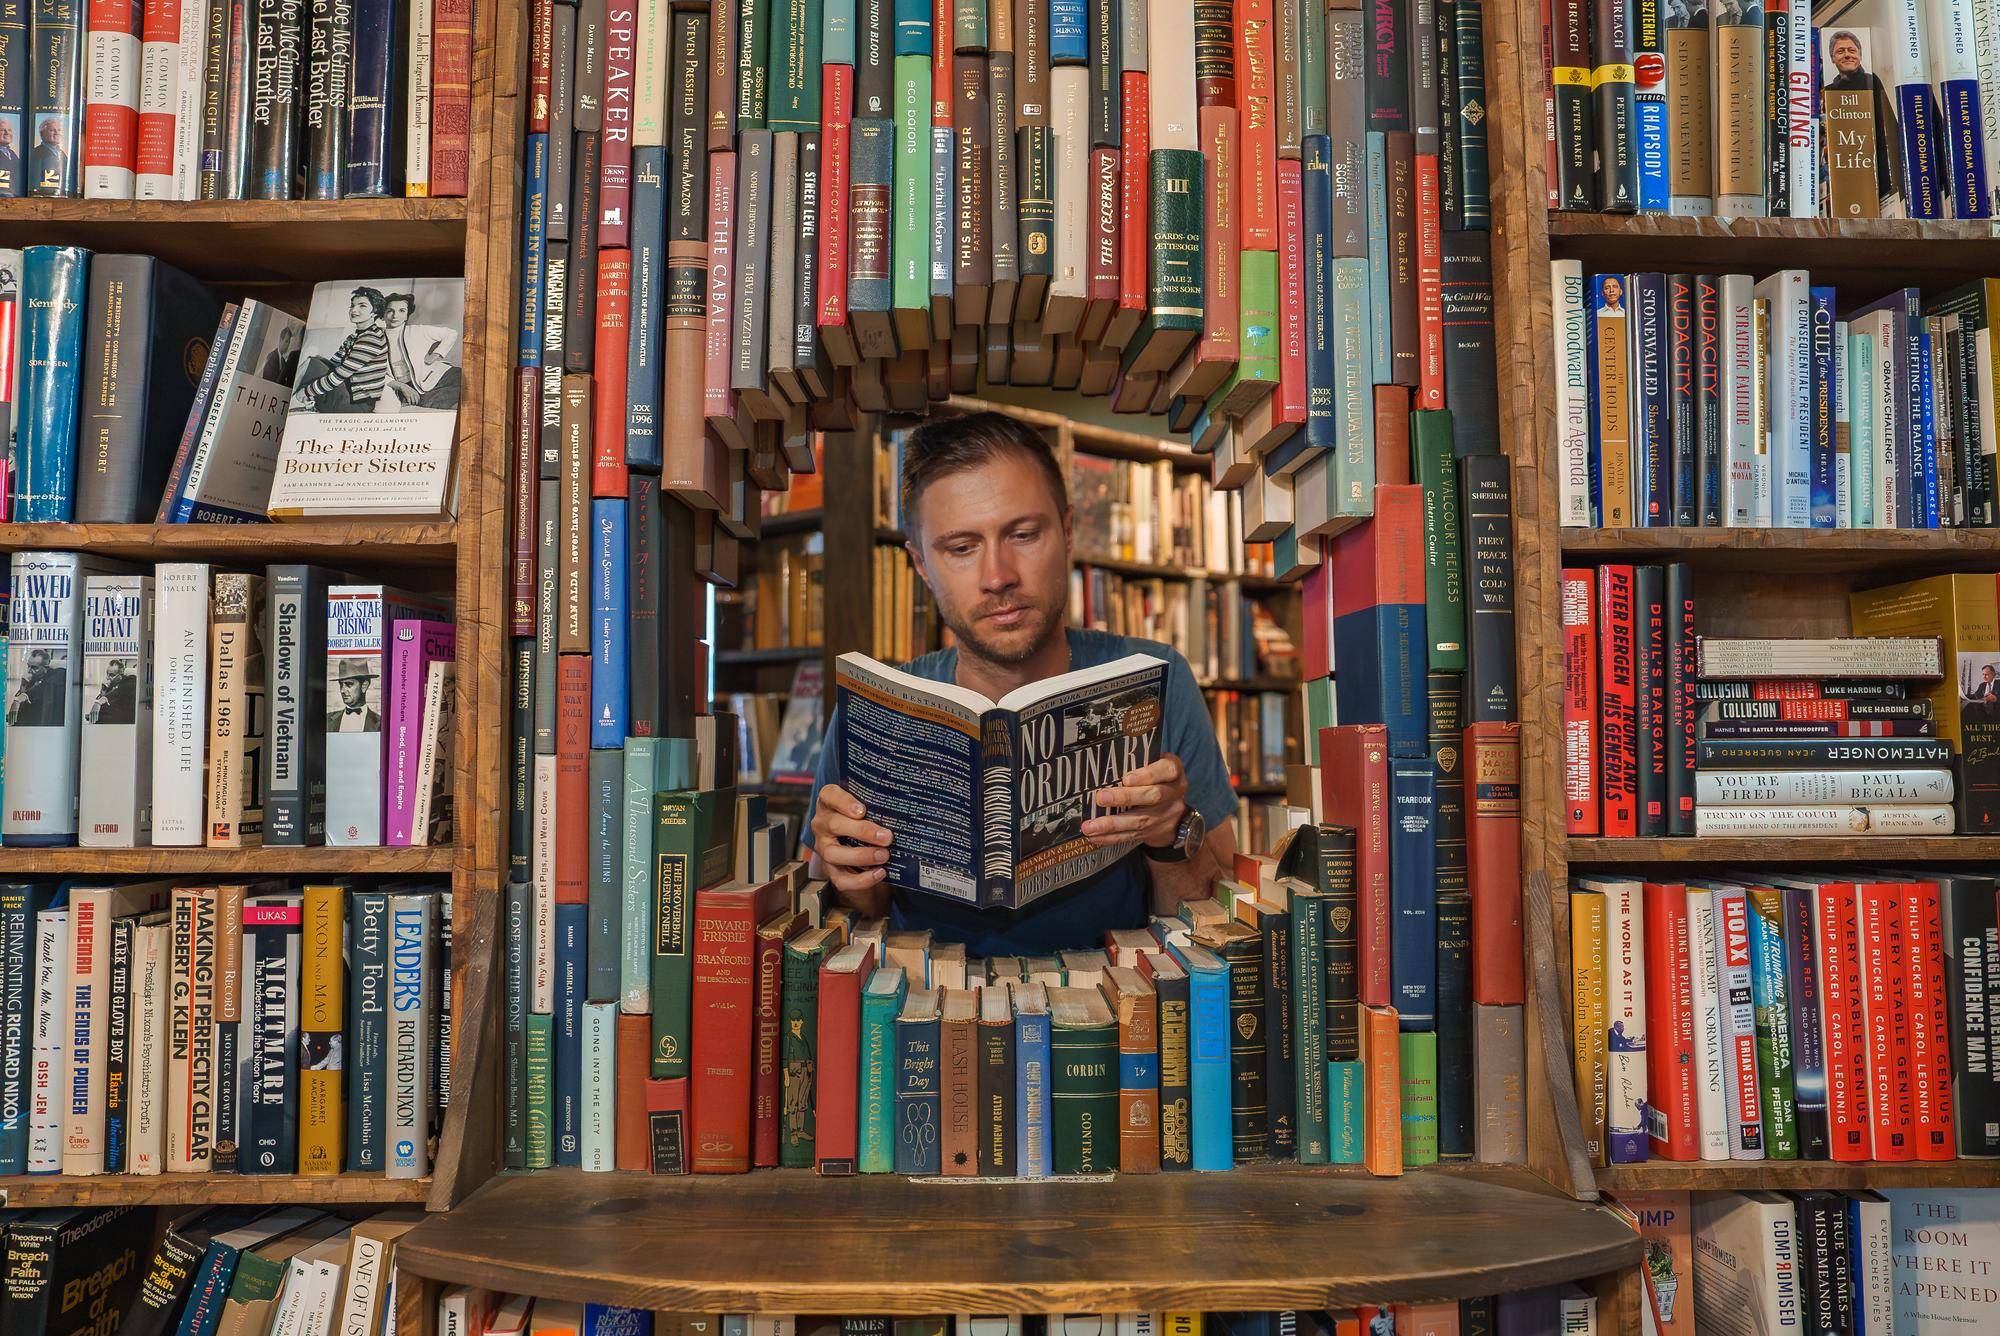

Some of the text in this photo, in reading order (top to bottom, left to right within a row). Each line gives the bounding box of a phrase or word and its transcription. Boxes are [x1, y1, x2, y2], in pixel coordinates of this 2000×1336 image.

[95, 36, 105, 98] STRUGGLE
[111, 46, 121, 102] COMMON
[308, 16, 332, 130] Last Brother
[605, 9, 632, 143] SPEAKER
[684, 18, 700, 116] STEVEN PRESSFIELD
[1789, 72, 1811, 148] GIVING
[1829, 108, 1871, 120] Clinton
[1840, 95, 1859, 107] Bill
[1643, 105, 1662, 178] RHAPSODY
[1835, 152, 1872, 170] Life
[1838, 131, 1867, 150] My
[1960, 90, 1978, 213] HILLARY RODHAM CLINTON
[961, 126, 973, 268] THIS BRIGHT RIVER
[1336, 163, 1347, 198] SCORE
[1101, 153, 1116, 266] THE CELEBRANT
[1287, 203, 1295, 227] THE
[1395, 160, 1408, 284] The Cove Ron Rash
[711, 218, 728, 327] THE CABAL
[545, 258, 566, 352] MARGARET MARON
[1289, 315, 1298, 357] BENCH
[1643, 288, 1658, 396] STONEWALLED
[1673, 282, 1691, 397] AUDACITY
[189, 306, 251, 491] THIRTEEN DAYS ROBERT F. KENNEDY
[543, 366, 562, 428] STORM TRACK
[1563, 275, 1586, 486] Bob Woodward The Agenda
[629, 428, 654, 437] INDEX
[631, 415, 653, 424] 1996
[98, 428, 110, 474] REPORT
[284, 457, 437, 475] Bouvier Sisters
[296, 439, 432, 456] The Fabulous
[1478, 537, 1504, 546] FIERY
[1487, 523, 1495, 531] A
[1477, 551, 1508, 560] PEACE
[1483, 565, 1503, 574] IN A
[87, 596, 140, 617] FLAWED
[328, 601, 382, 619] LONE STAR
[1479, 580, 1507, 589] COLD
[1483, 594, 1505, 603] WAR
[92, 618, 134, 638] GIANT
[337, 618, 373, 635] RISING
[1611, 574, 1630, 687] PETER BERGEN
[180, 630, 195, 773] AN UNFINISHED LIFE
[216, 631, 235, 739] Dallas 1963
[274, 603, 297, 780] Shadows of Vietnam
[1650, 604, 1663, 774] DEVIL'S BARGAIN
[1723, 704, 1909, 719] COLLUSION LUKE HARDING
[1020, 713, 1056, 770] NO
[1827, 747, 1949, 760] HATEMONGER
[1020, 727, 1157, 814] ORDINARY
[1714, 775, 1779, 787] YOU'RE
[1721, 788, 1777, 800] FIRED
[1851, 787, 1919, 799] BEGALA
[1862, 774, 1906, 786] PAUL
[1397, 795, 1432, 804] YEARBOOK
[76, 902, 94, 976] HALDEMAN
[257, 911, 287, 921] LUKAS
[1727, 902, 1747, 962] HOAX
[356, 899, 385, 1014] Betty Ford
[394, 909, 423, 1013] LEADERS
[1621, 891, 1633, 1019] THE WORLD AS IT IS
[190, 897, 216, 1162] MAKING IT PERFECTLY CLEAR
[264, 957, 287, 1105] NIGHTMARE
[1908, 897, 1930, 1123] PHILIP RUCKER CAROL LEONNIG
[1927, 898, 1950, 1123] A VERY STABLE GENIUS
[1963, 937, 1987, 1073] CONFIDENCE MAN
[72, 985, 94, 1115] THE ENDS OF POWER
[396, 1020, 415, 1129] RICHARD NIXON
[903, 1057, 935, 1073] Bright
[908, 1041, 930, 1053] This
[1066, 1064, 1106, 1077] CORBIN
[1740, 1040, 1752, 1074] BRIAN
[36, 1060, 49, 1115] GISH JEN
[592, 1018, 601, 1135] GOING INTO THE CITY
[908, 1075, 930, 1089] Day
[952, 1028, 969, 1133] FLASH HOUSE
[1742, 1075, 1756, 1118] STELTER
[1904, 1229, 1968, 1247] ROOM
[1913, 1203, 1957, 1219] THE
[9, 1251, 48, 1262] Breach
[10, 1267, 41, 1278] Faith
[21, 1260, 32, 1270] of
[1814, 1210, 1832, 1329] MISDEMEANORS
[1832, 1210, 1848, 1312] TRUE CRIMES
[347, 1243, 375, 1336] ONE OF US
